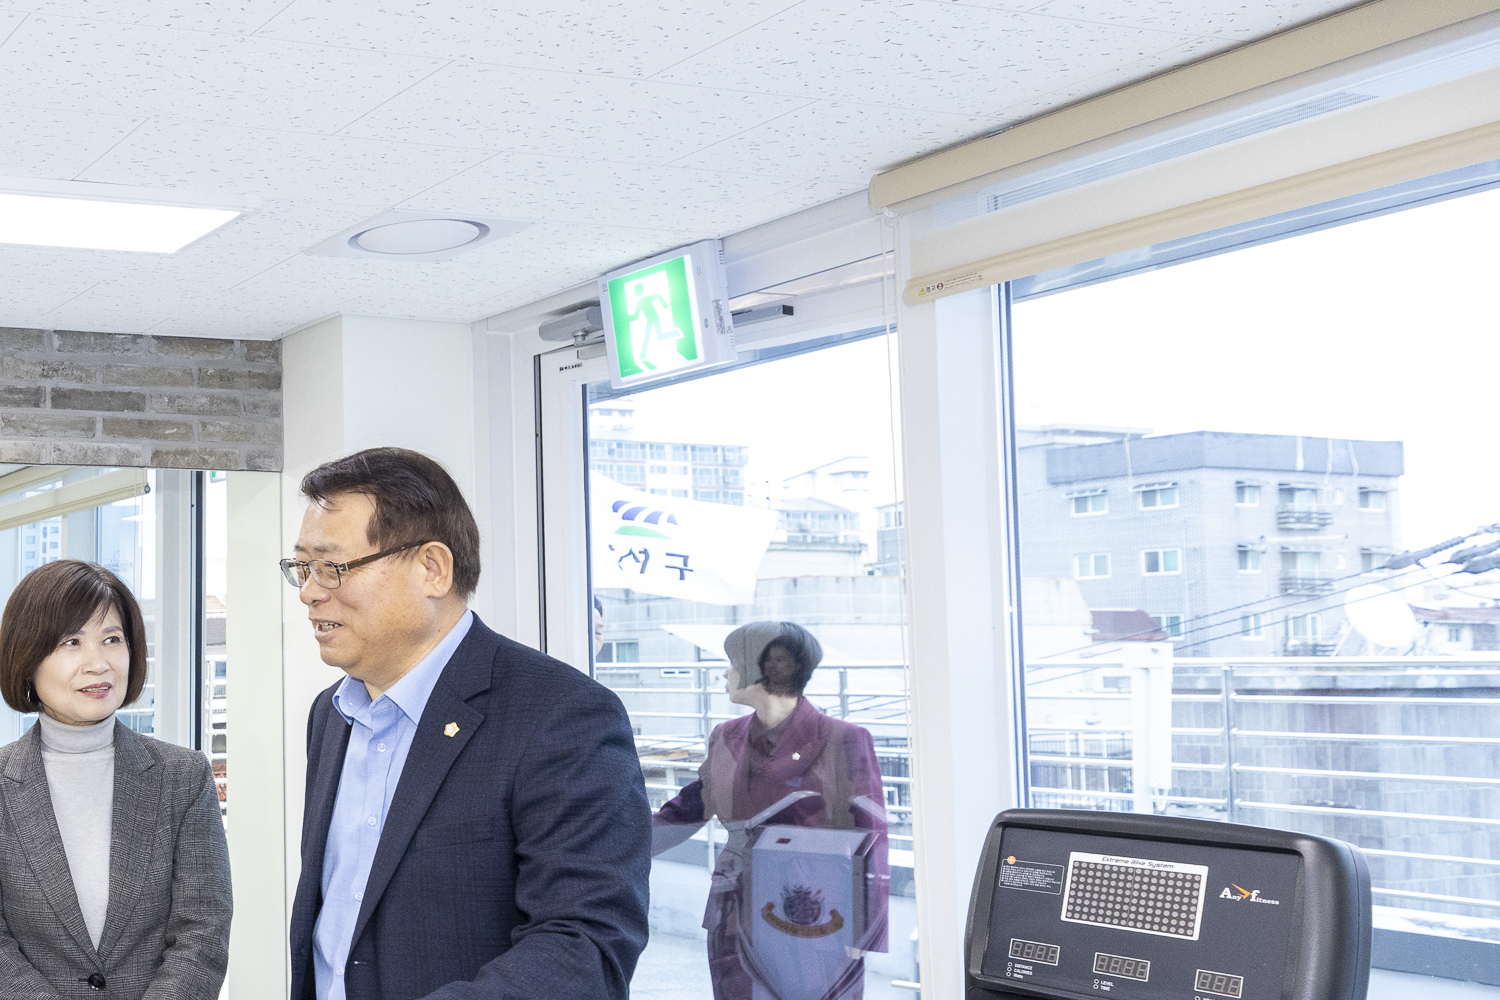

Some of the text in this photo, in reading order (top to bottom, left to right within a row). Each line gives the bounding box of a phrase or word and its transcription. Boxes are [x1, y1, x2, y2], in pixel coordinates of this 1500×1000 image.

[1102, 856, 1129, 865] Extreme
[1147, 861, 1174, 869] System
[1219, 887, 1242, 902] Any
[1013, 968, 1033, 976] CALORIES
[1014, 963, 1033, 971] DISTANCE
